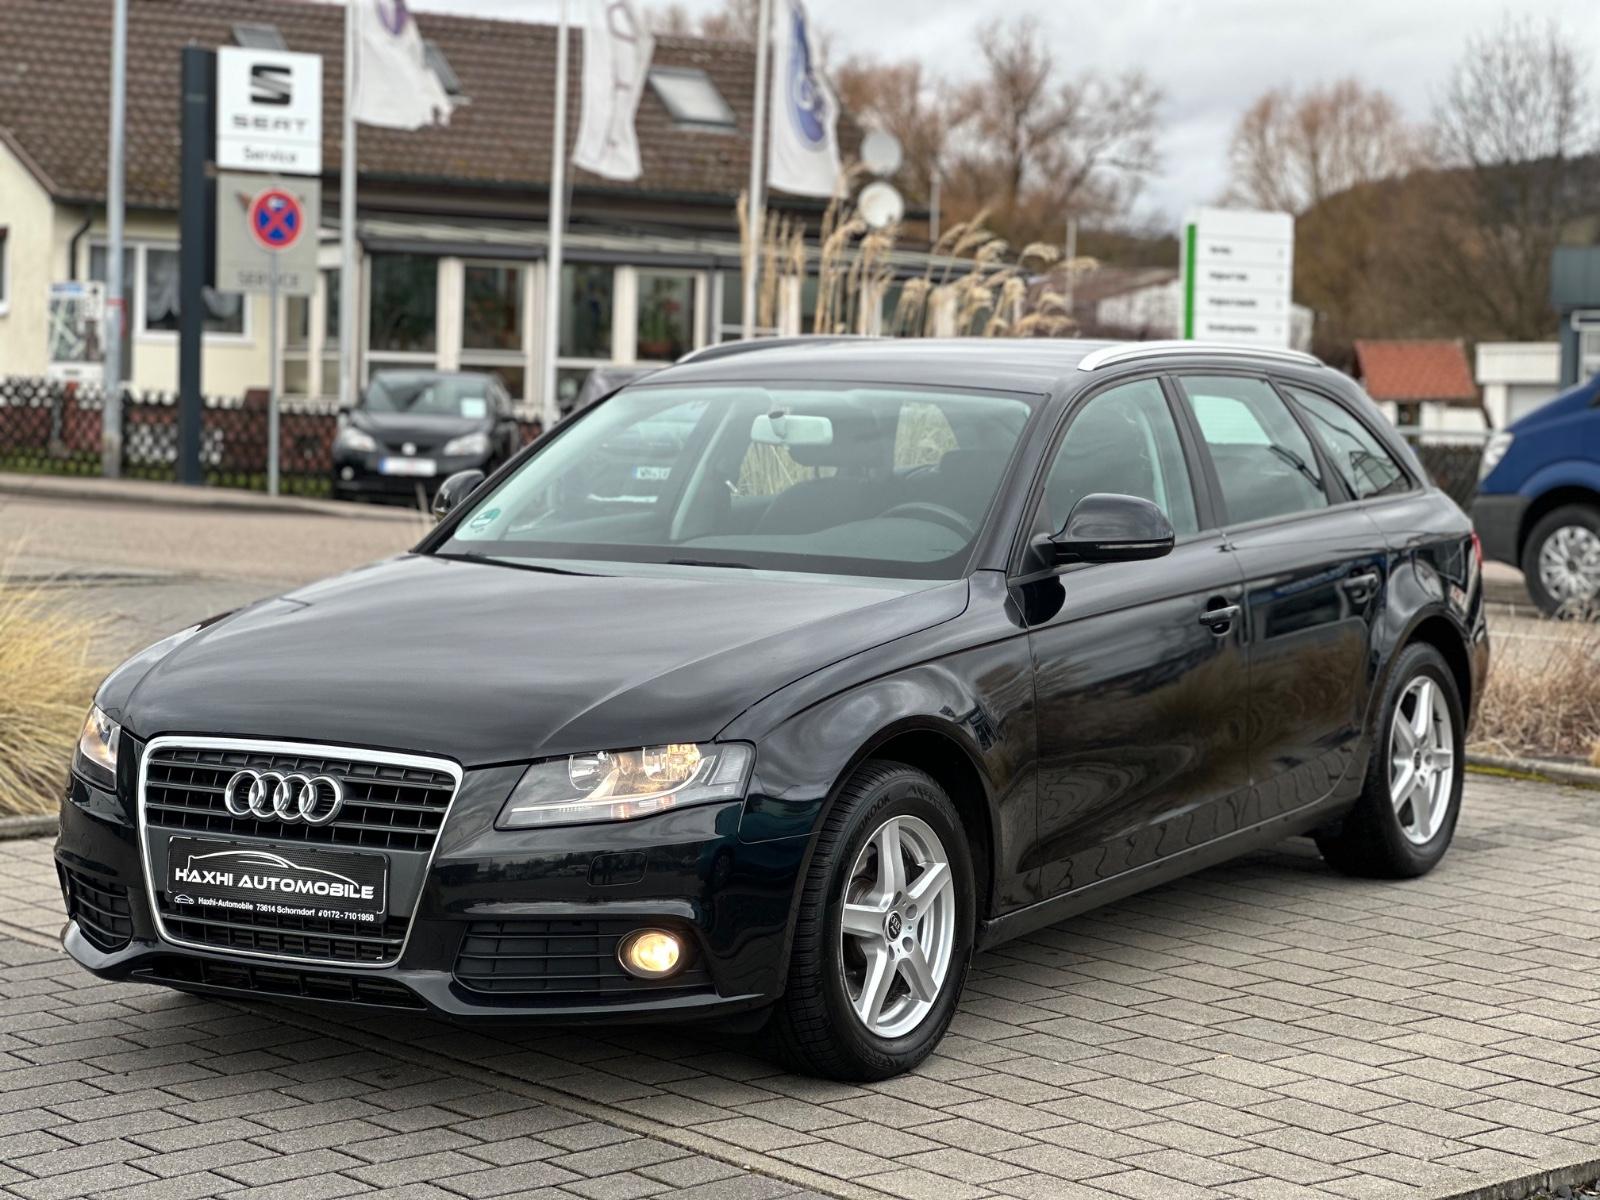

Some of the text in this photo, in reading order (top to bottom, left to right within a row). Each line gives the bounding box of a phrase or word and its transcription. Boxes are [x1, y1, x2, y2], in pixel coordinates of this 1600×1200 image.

[232, 115, 308, 132] SEAT
[243, 146, 297, 163] Service
[175, 868, 375, 900] HAXHI AUTOMOBILE
[198, 896, 254, 910] Haxhi-Automobile
[256, 903, 276, 913] 73614
[277, 905, 316, 917] Schorndorf
